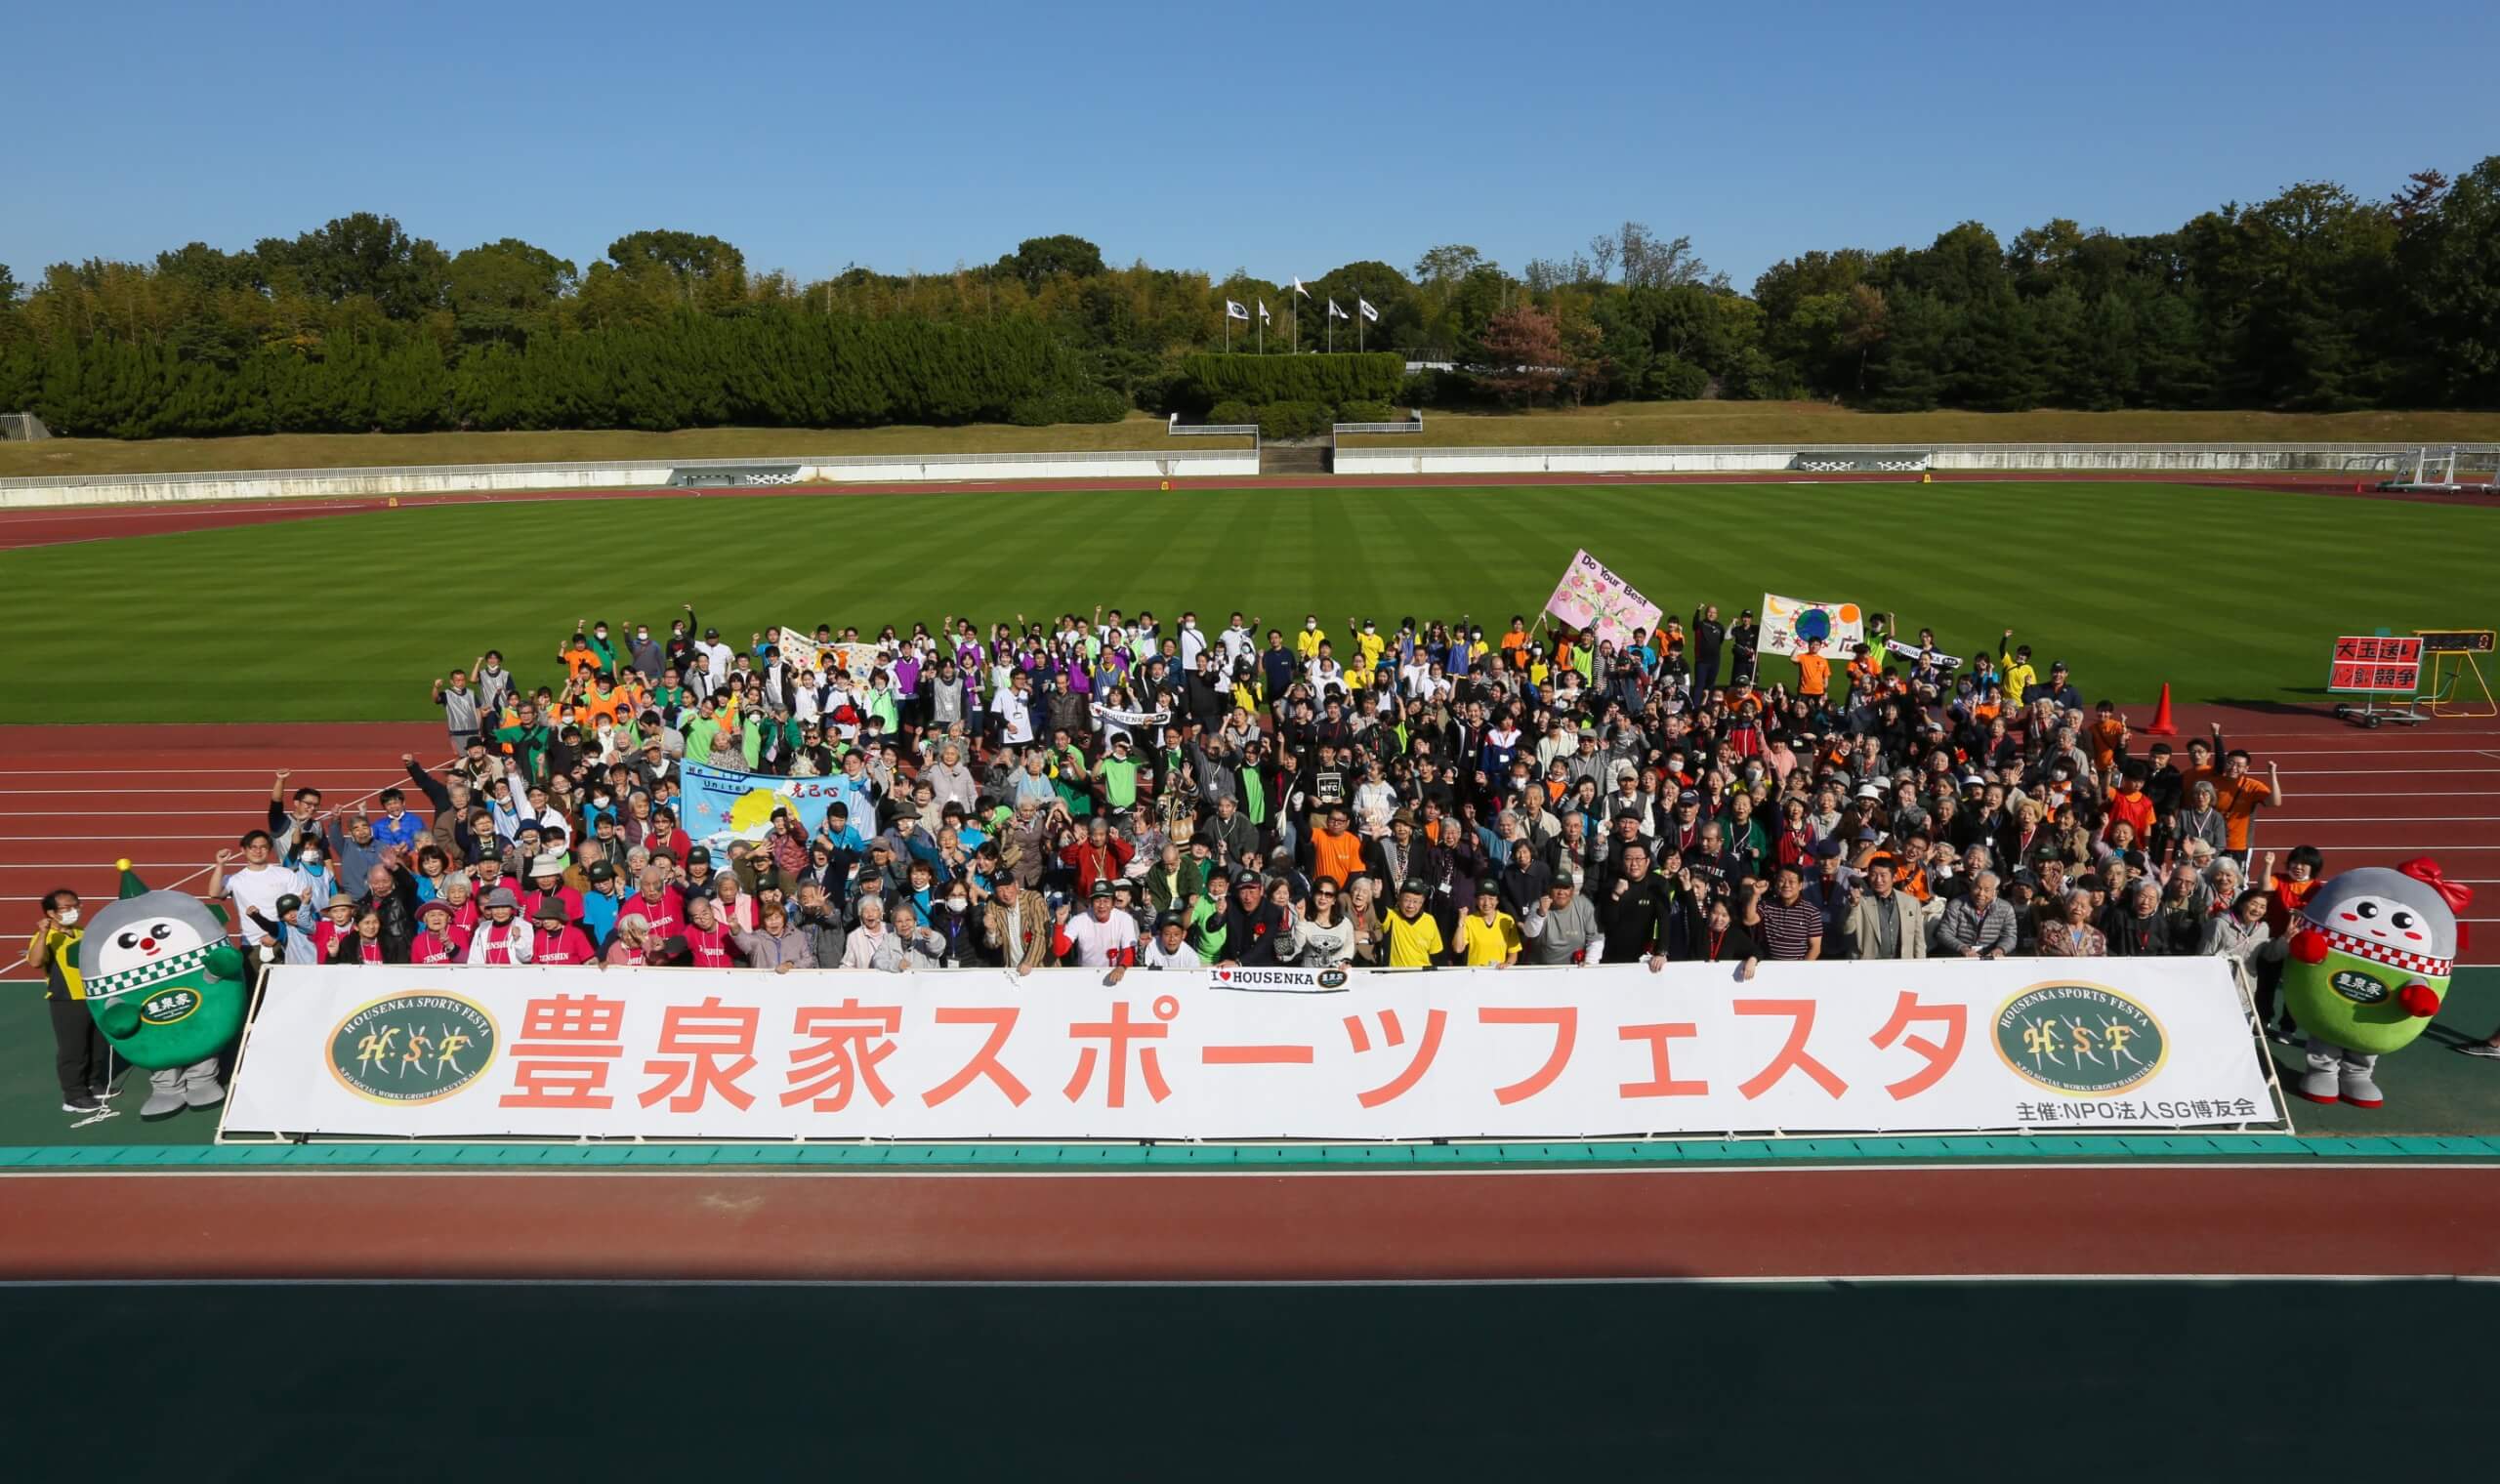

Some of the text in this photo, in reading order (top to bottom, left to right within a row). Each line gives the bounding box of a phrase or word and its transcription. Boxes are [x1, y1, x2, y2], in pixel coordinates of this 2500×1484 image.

[1582, 555, 1647, 607] Do Your Best
[2338, 641, 2421, 659] 大玉送り
[1211, 970, 1218, 981] I
[1233, 971, 1313, 985] HOUSENKA
[344, 998, 491, 1038] HOUSENKA SPORTS FESTA
[2000, 988, 2148, 1028] HOUSENKA SPORTS FESTA
[498, 991, 1968, 1113] 豊泉家スポーツフェスタ
[354, 1080, 377, 1095] SOCIAL
[378, 1090, 403, 1099] WORKS
[405, 1091, 431, 1099] GROUP
[2033, 1074, 2061, 1088] SOCIAL
[2062, 1083, 2091, 1092] WORKS
